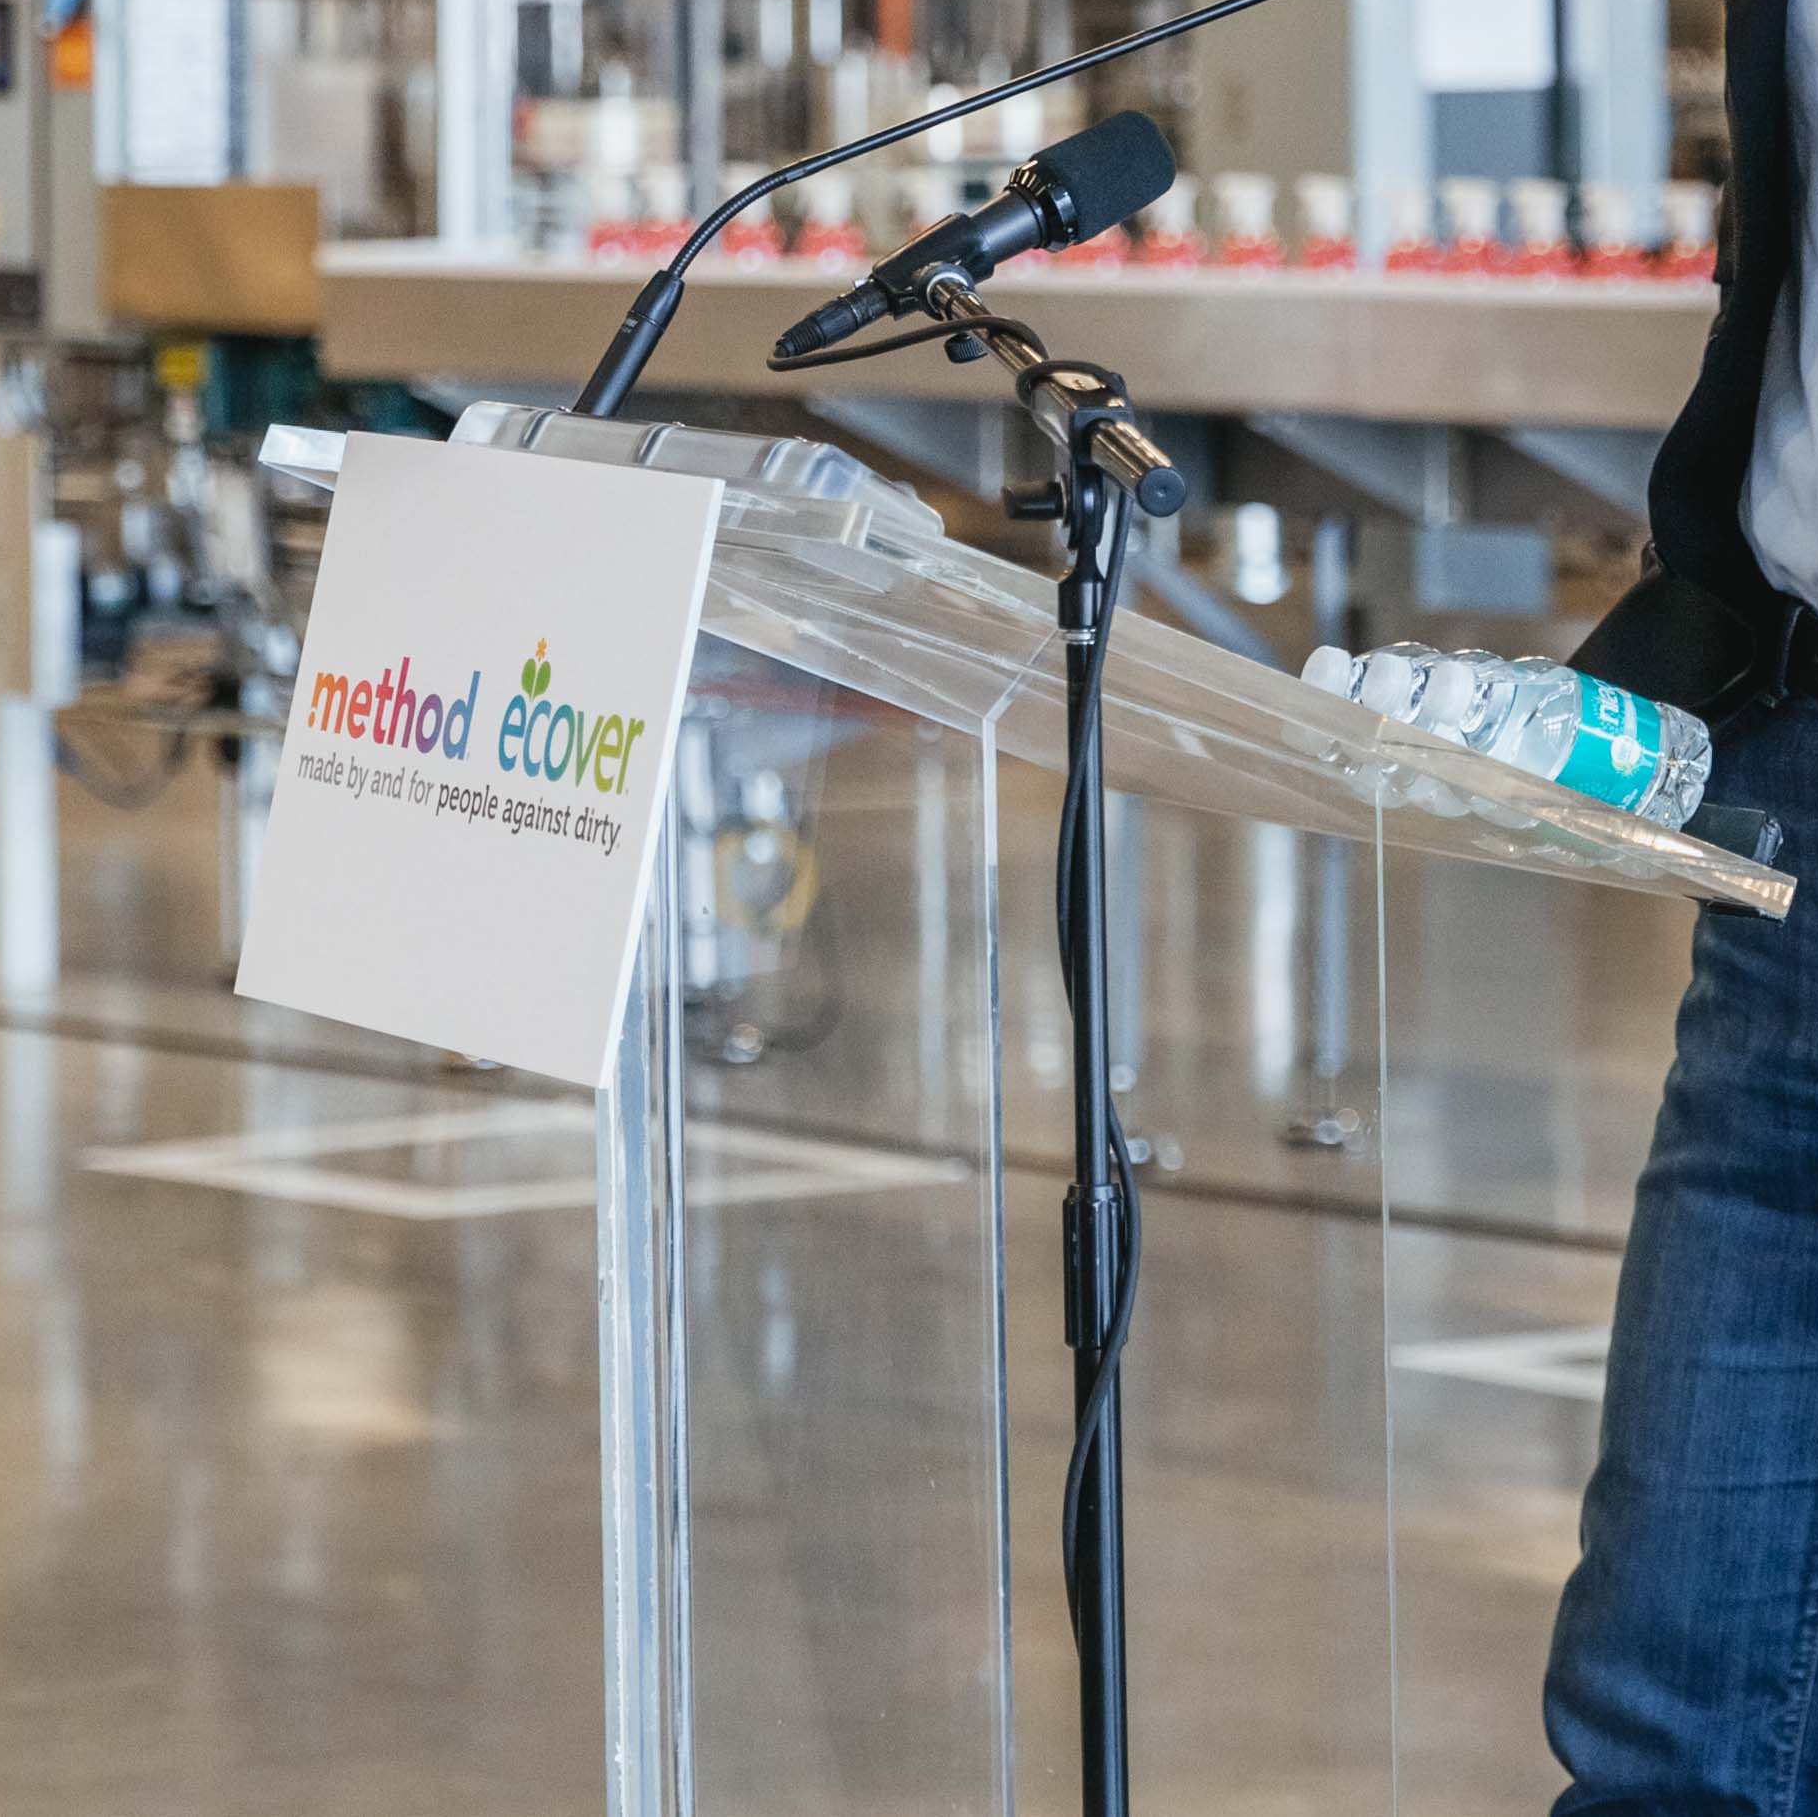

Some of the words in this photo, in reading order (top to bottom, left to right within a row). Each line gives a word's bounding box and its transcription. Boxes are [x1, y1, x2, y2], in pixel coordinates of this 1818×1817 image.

[307, 656, 482, 761] method
[498, 693, 646, 796] ecover
[297, 752, 344, 786] made
[347, 755, 370, 800] by
[370, 767, 406, 800] and
[408, 769, 435, 806] for
[436, 783, 499, 825] people
[502, 796, 572, 835] against
[574, 806, 622, 857] dirty
